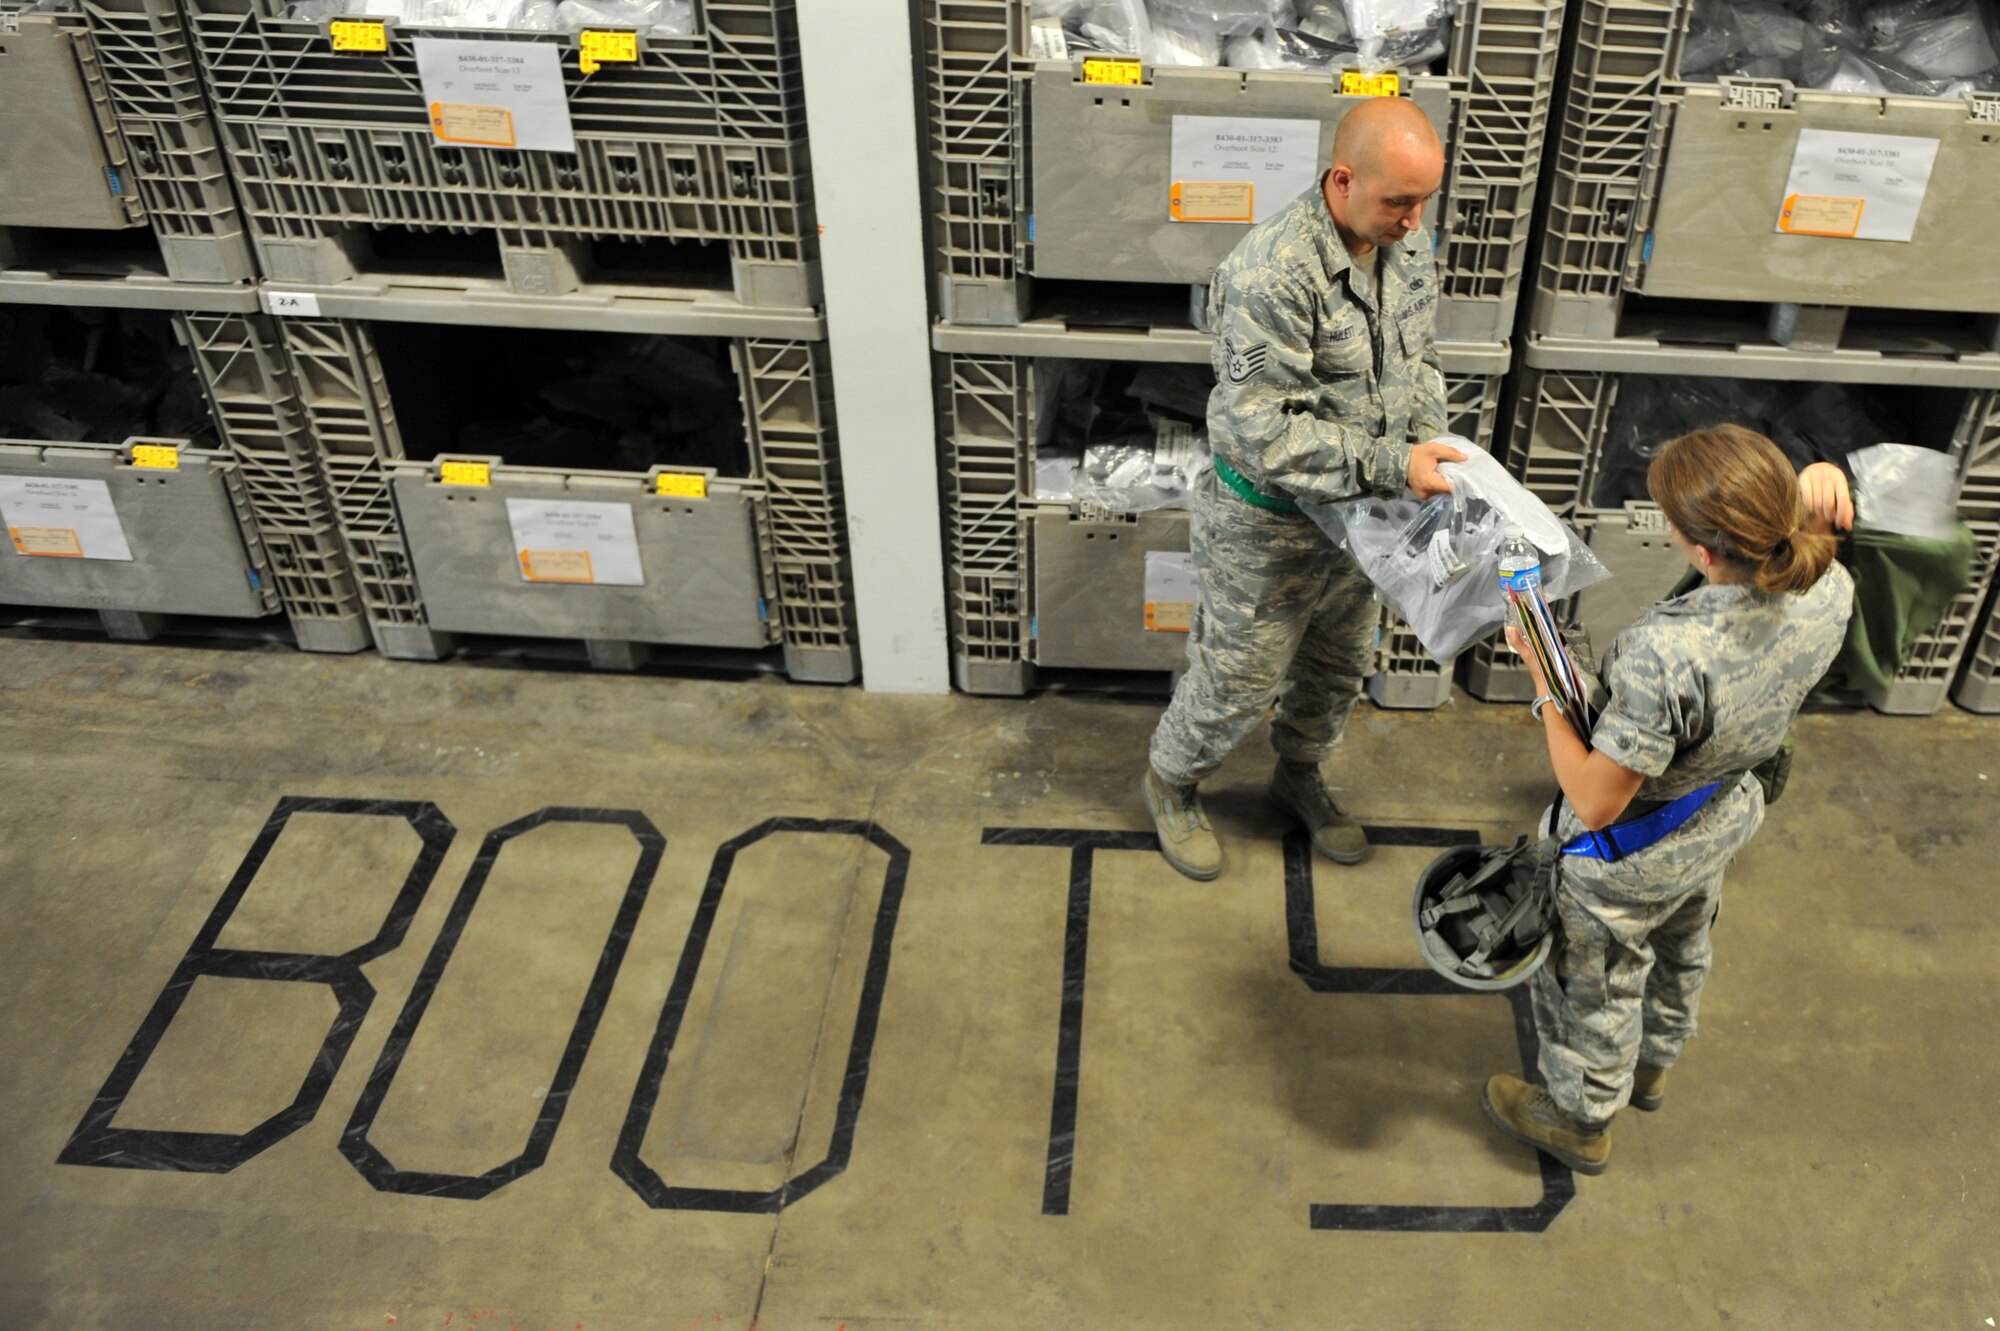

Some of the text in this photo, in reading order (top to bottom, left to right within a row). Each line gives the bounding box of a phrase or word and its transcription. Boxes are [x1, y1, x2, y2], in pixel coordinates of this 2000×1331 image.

[1214, 144, 1248, 152] Overboot
[1250, 145, 1266, 153] Size
[56, 795, 1576, 1232] BOOTS
